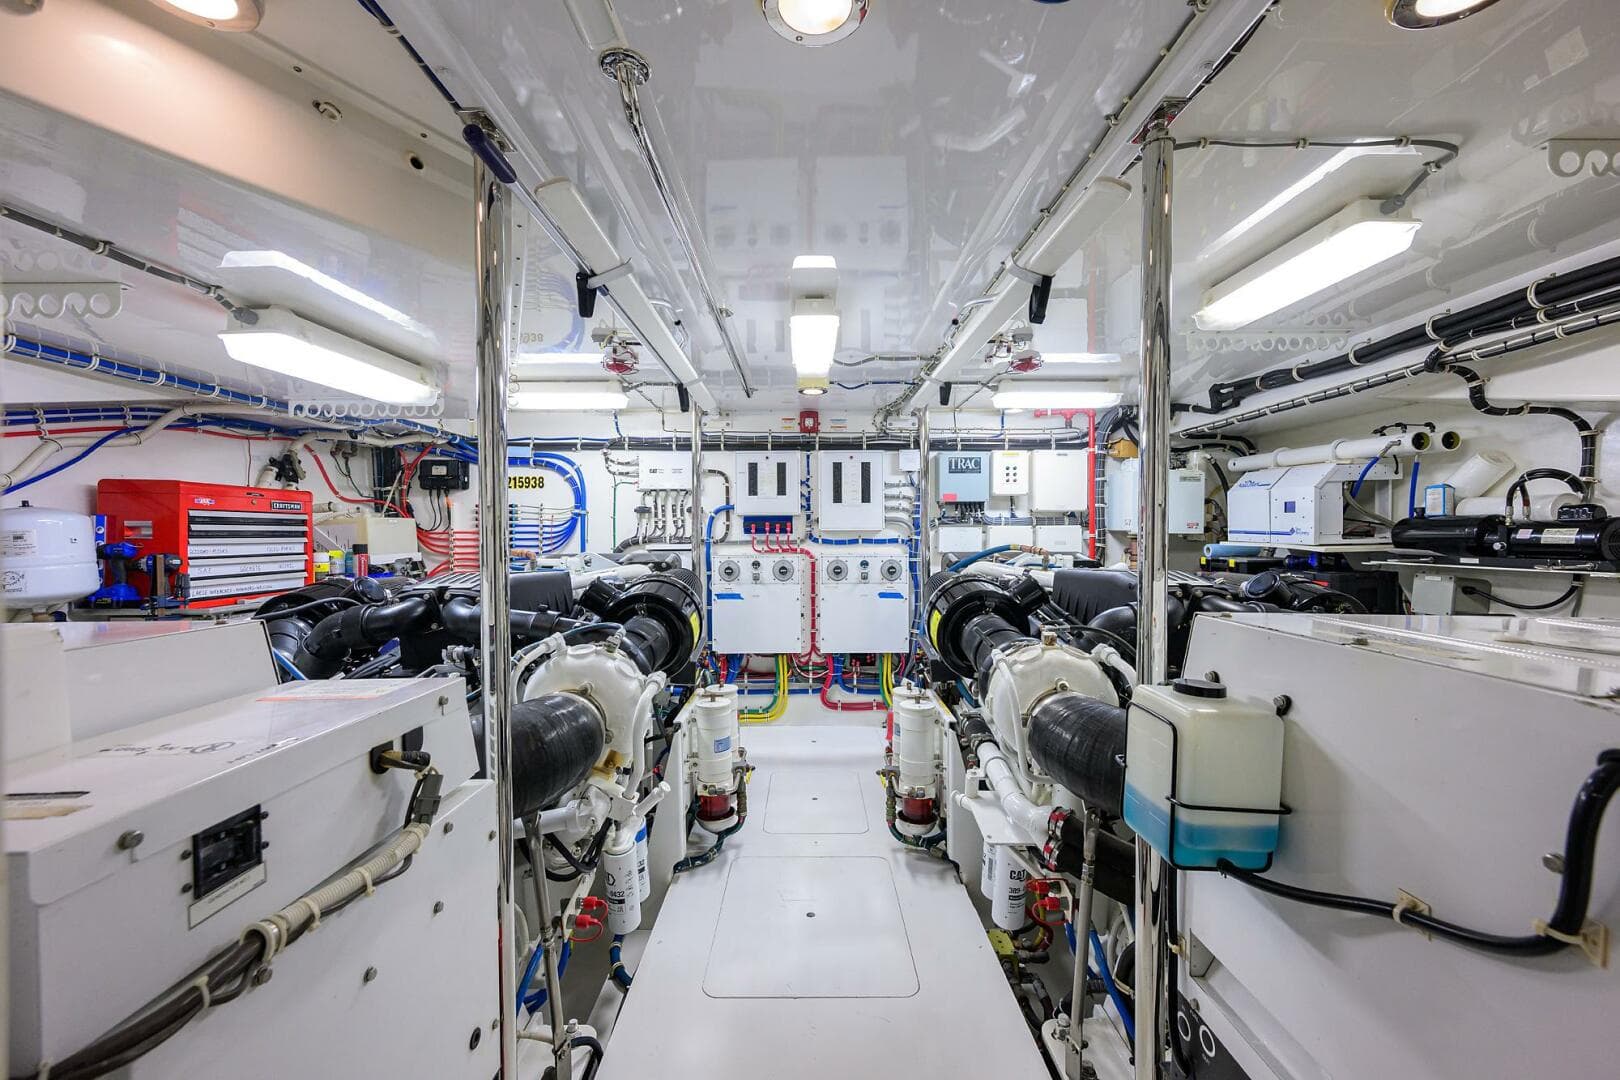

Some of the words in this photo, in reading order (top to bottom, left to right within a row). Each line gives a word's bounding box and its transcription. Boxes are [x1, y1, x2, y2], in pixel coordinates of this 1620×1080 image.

[948, 457, 981, 470] TRAC
[273, 502, 301, 510] CRAFTSMAN
[1009, 869, 1026, 881] CAT
